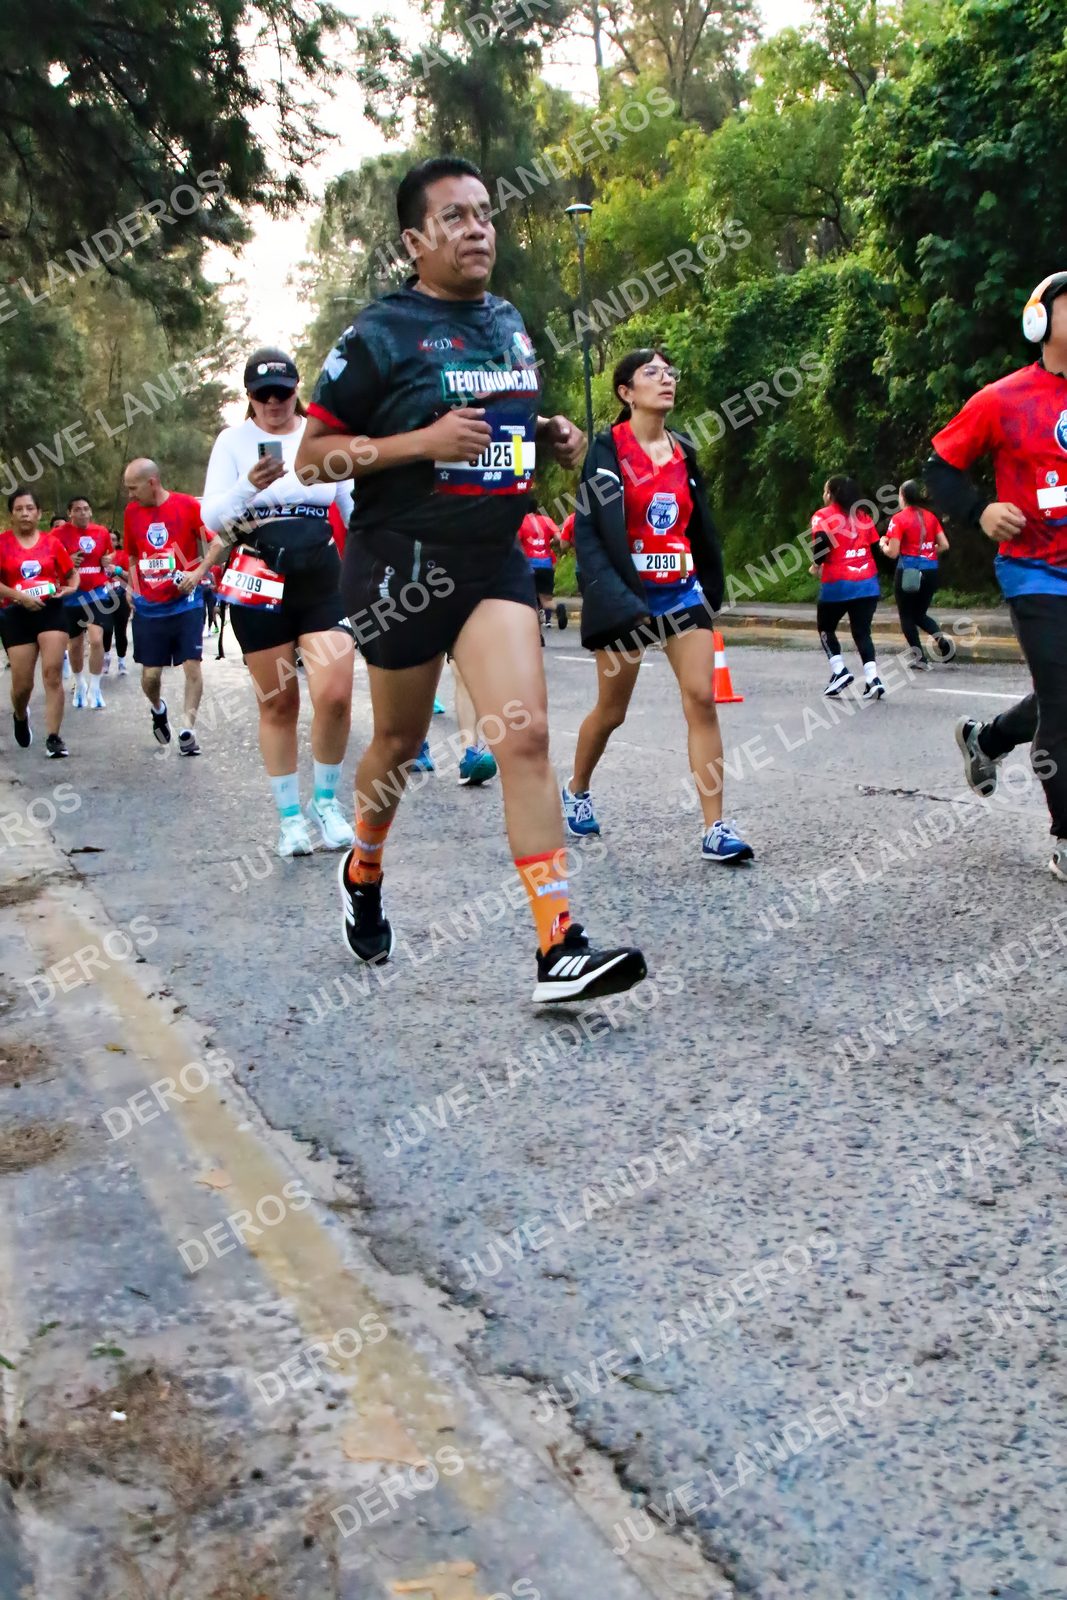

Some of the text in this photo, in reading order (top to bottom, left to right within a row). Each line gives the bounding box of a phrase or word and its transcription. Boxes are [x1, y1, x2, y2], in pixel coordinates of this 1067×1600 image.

[445, 369, 538, 392] TEOTIHUACAN
[256, 506, 291, 518] NIKE
[294, 505, 325, 517] PRO
[646, 555, 676, 569] 2030
[235, 573, 262, 593] 2709
